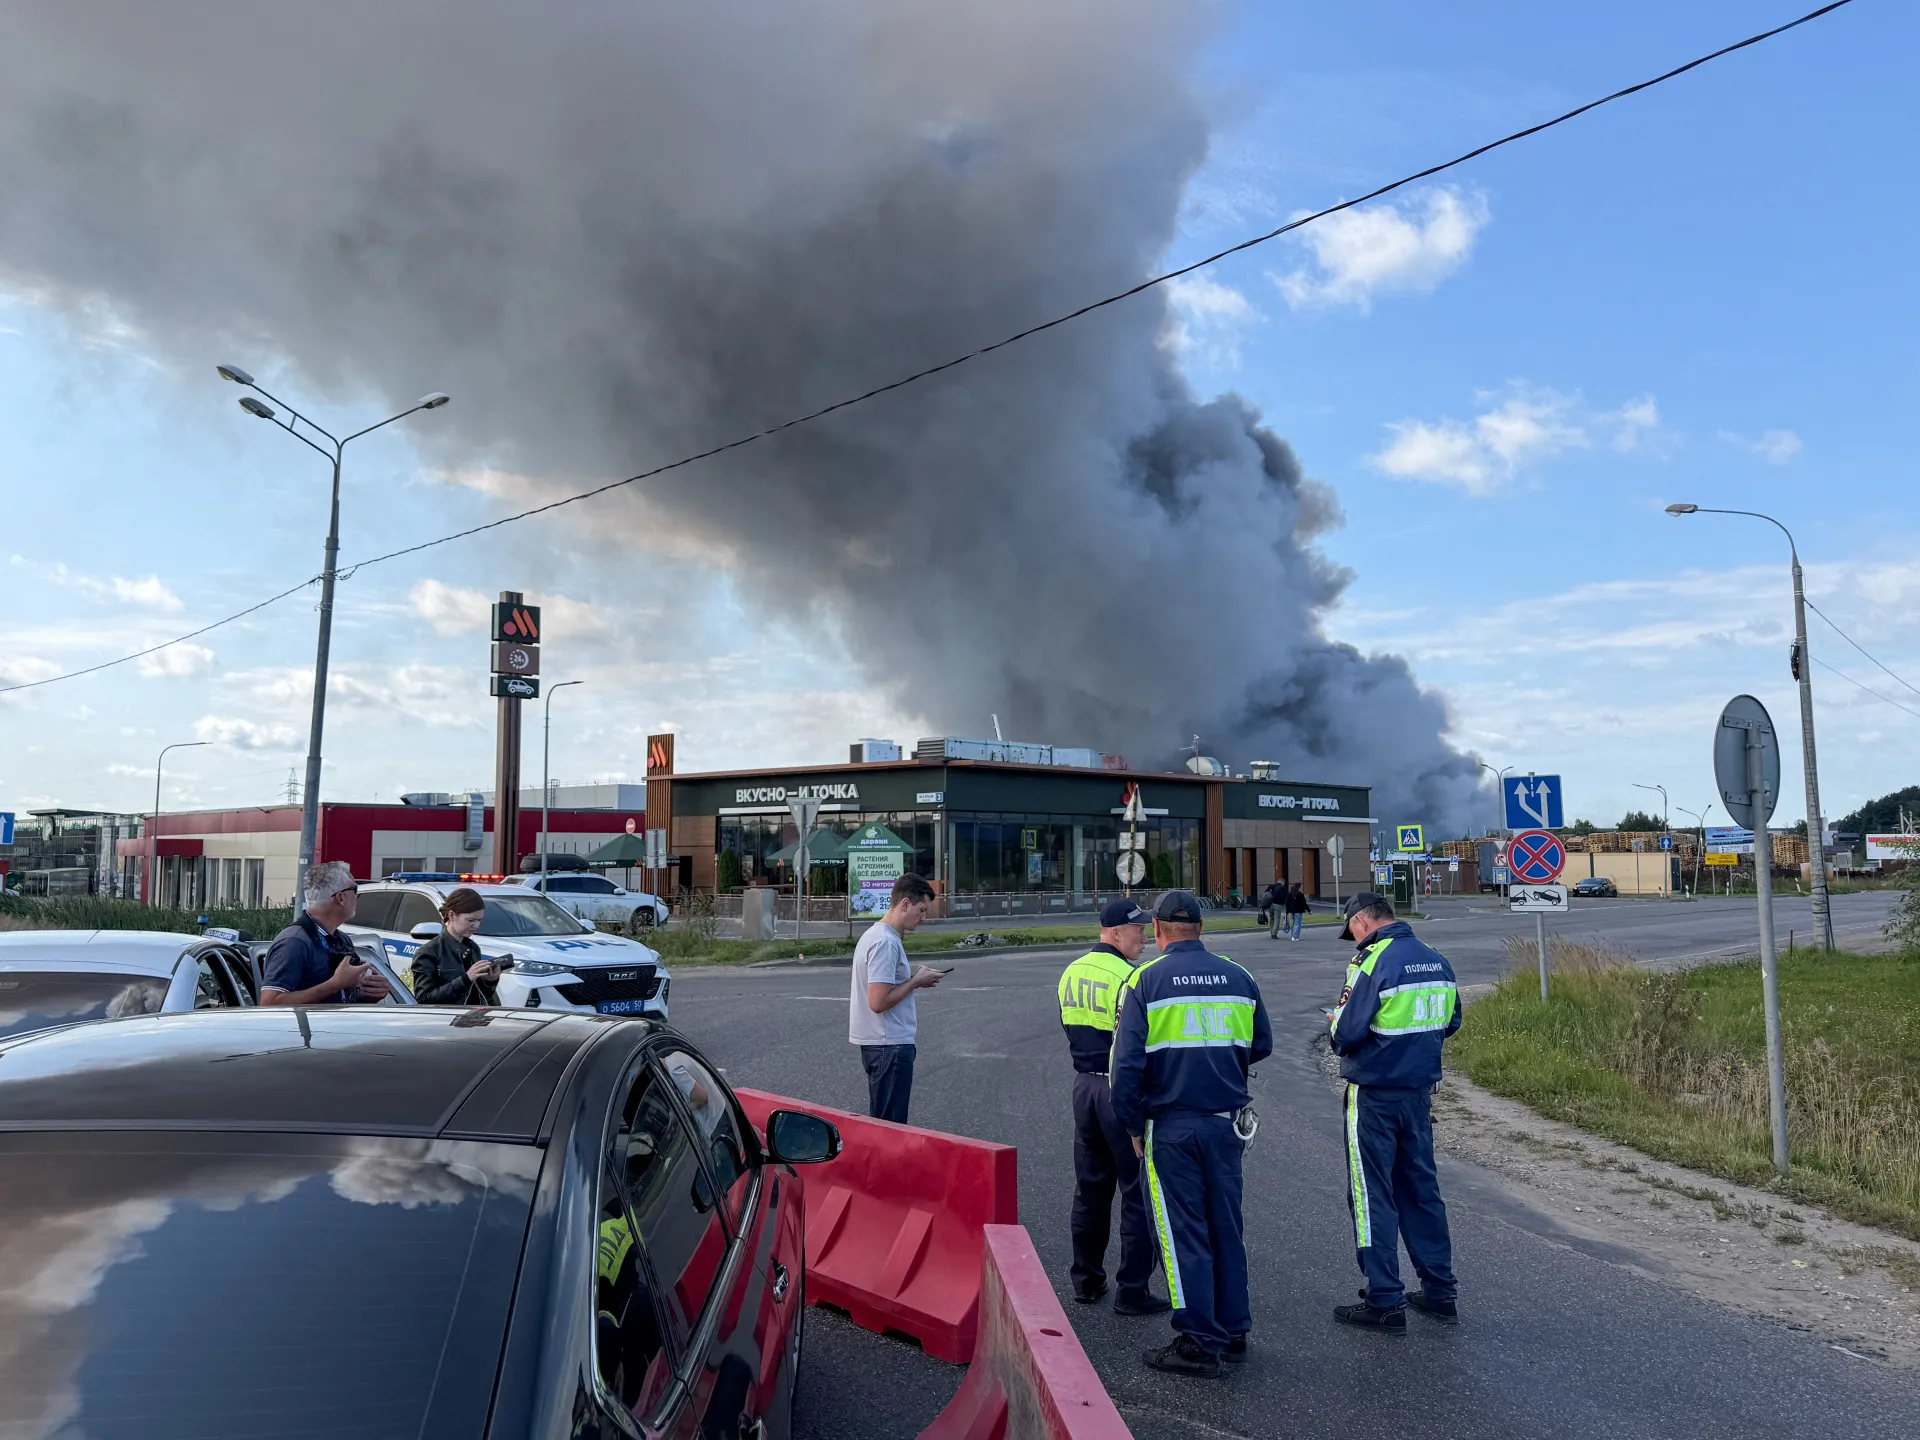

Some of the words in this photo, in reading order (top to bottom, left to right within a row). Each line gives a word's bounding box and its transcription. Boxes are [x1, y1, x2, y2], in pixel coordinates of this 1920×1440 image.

[810, 783, 860, 800] ТОЧКА
[1311, 797, 1340, 811] ТОЧКА
[1404, 962, 1443, 974] ПОЛИЦИЯ
[1172, 974, 1228, 986] ПОЛИЦИЯ
[1062, 975, 1110, 1015] ДПС
[611, 1001, 630, 1012] 5604
[1181, 1006, 1233, 1037] ДПС
